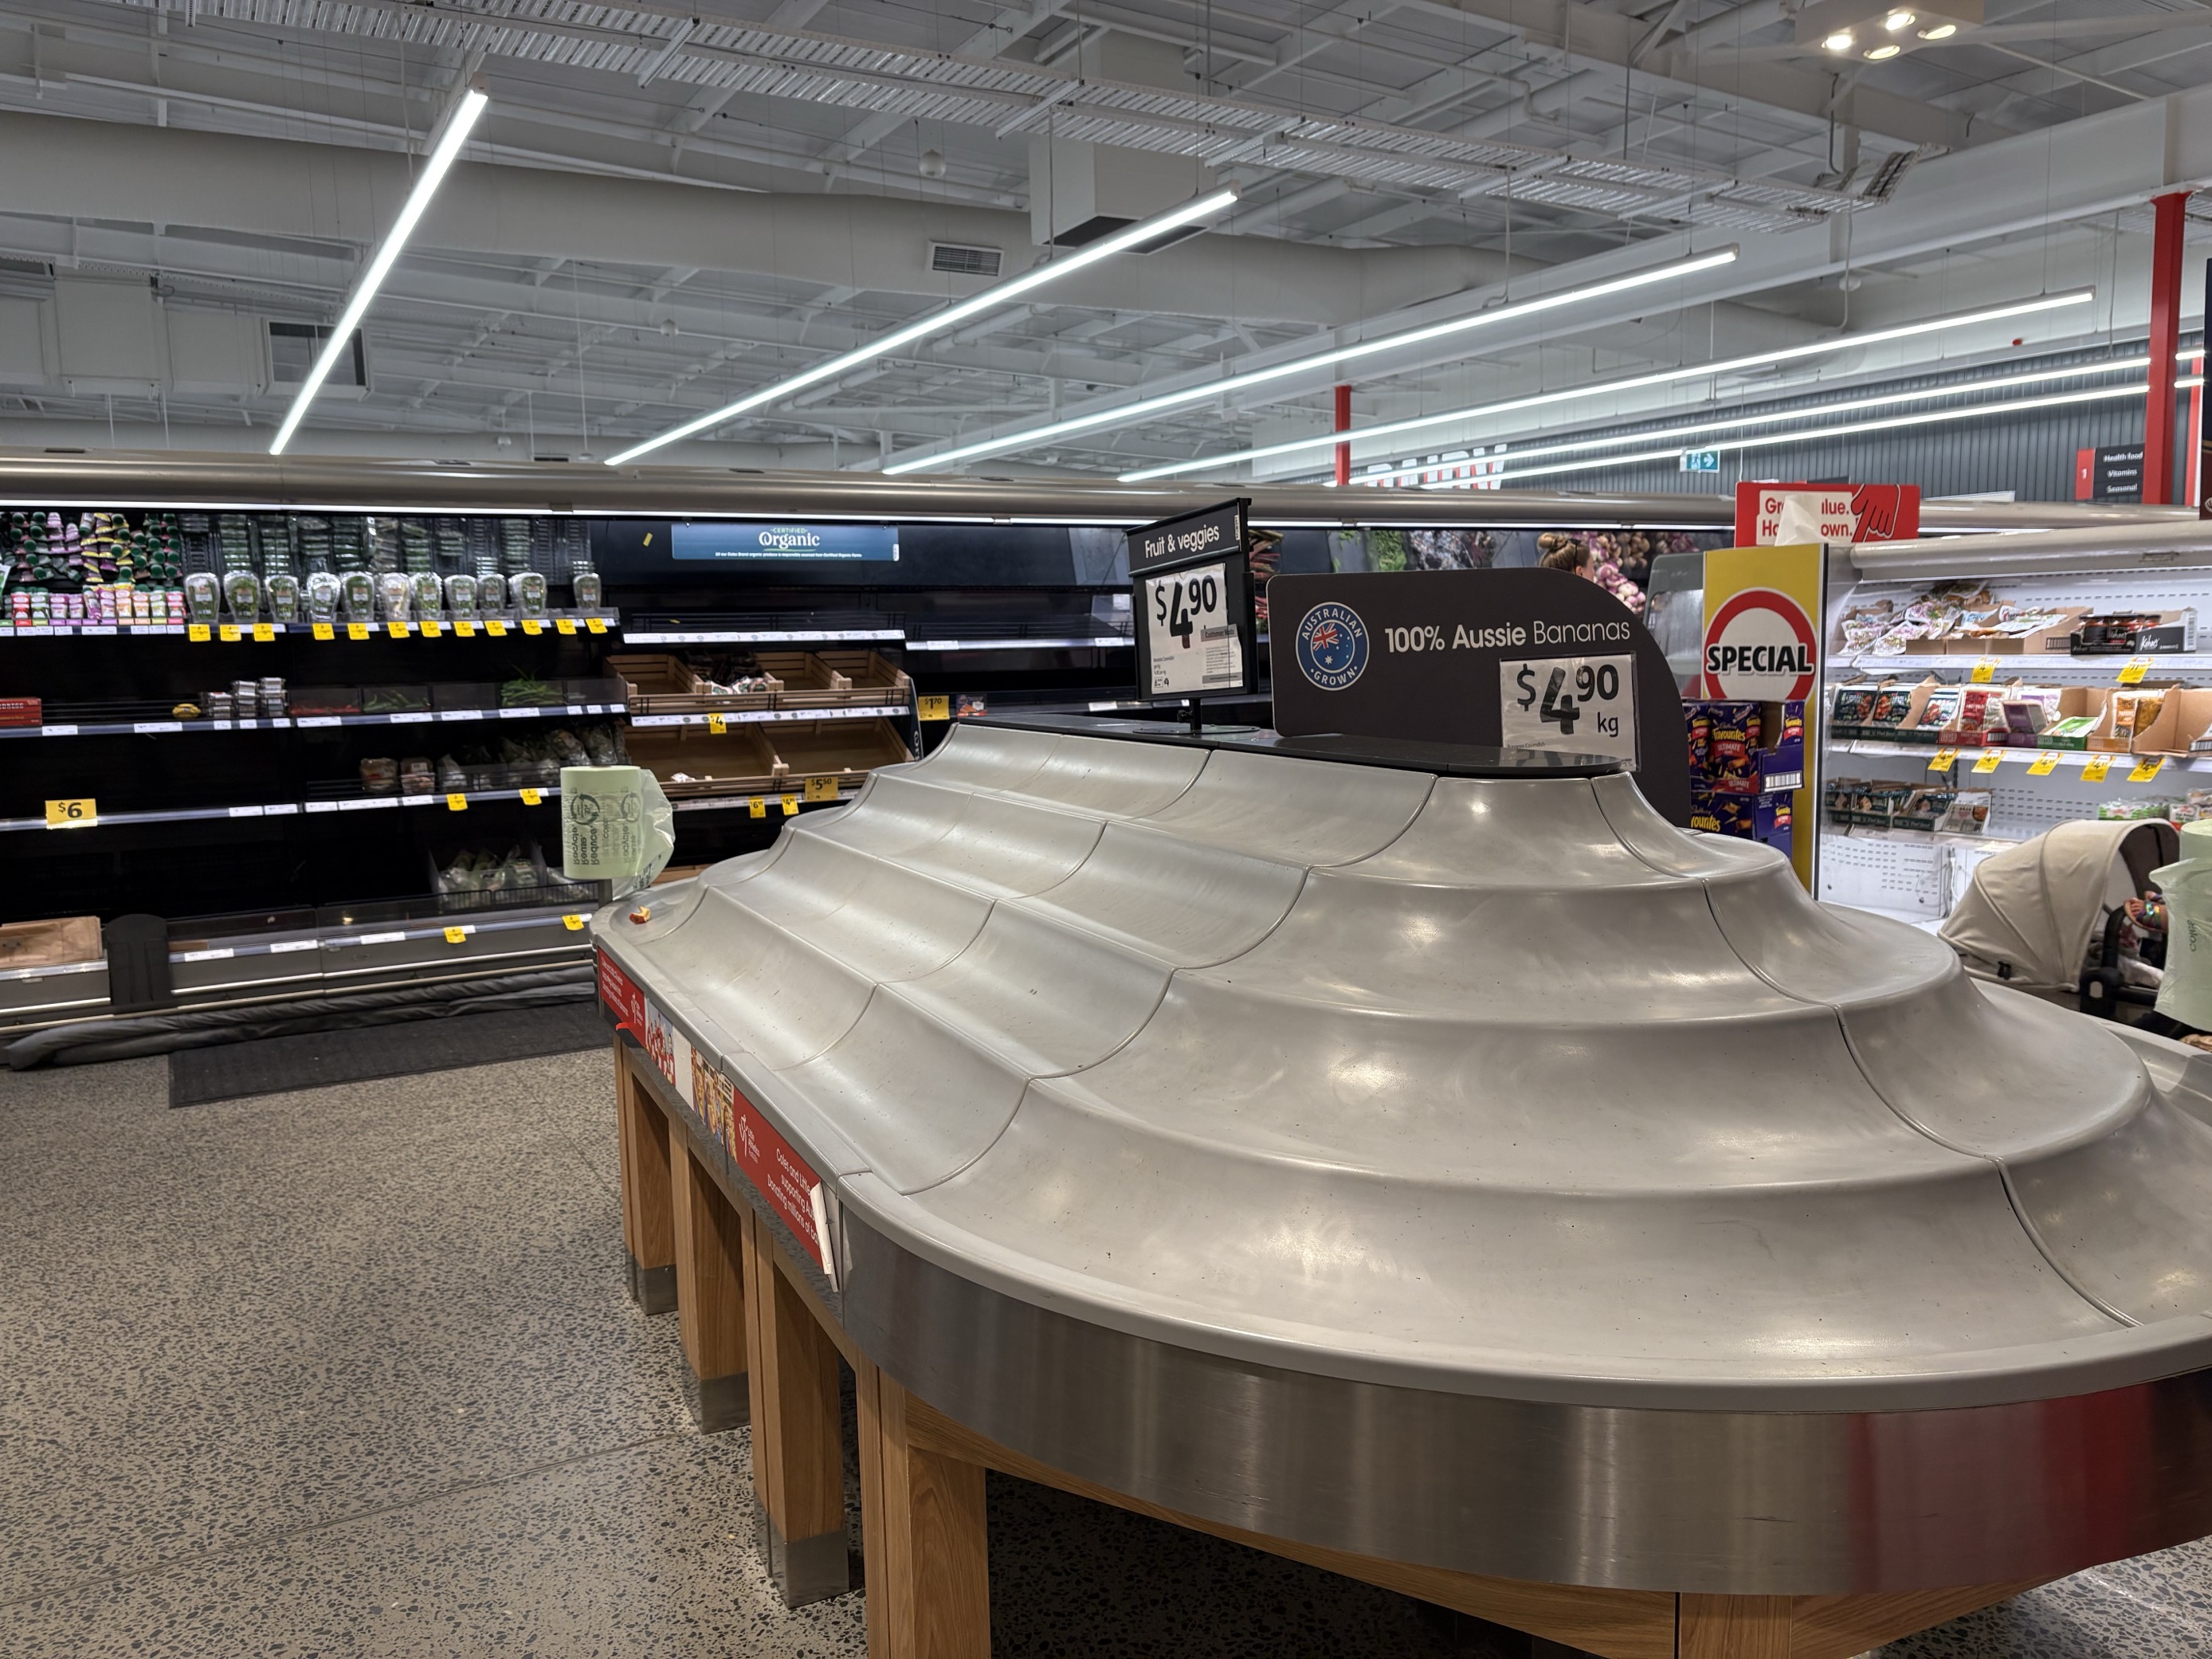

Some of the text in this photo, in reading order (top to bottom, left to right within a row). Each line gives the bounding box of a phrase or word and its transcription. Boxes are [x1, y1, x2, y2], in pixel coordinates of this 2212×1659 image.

[2104, 451, 2143, 462] Health food
[2081, 469, 2088, 480] 1
[2107, 469, 2137, 478] Vitamins
[2106, 483, 2137, 493] Seasonal
[759, 531, 821, 550] Organic
[1144, 539, 1165, 558] Fruit
[1167, 534, 1176, 552] &
[1178, 524, 1220, 551] veggies
[1302, 608, 1363, 641] AUSTRALIAN
[1385, 620, 1630, 653] 100% Aussie Bananas
[1707, 645, 1813, 673] SPECIAL
[1314, 668, 1356, 685] GROWN
[1597, 711, 1618, 738] kg
[58, 802, 83, 818] $6
[776, 1148, 789, 1171] Coles
[789, 1167, 799, 1183] and
[767, 1173, 787, 1210] Donating
[788, 1202, 805, 1229] millions
[805, 1221, 811, 1234] of
[781, 1175, 805, 1214] supporting
